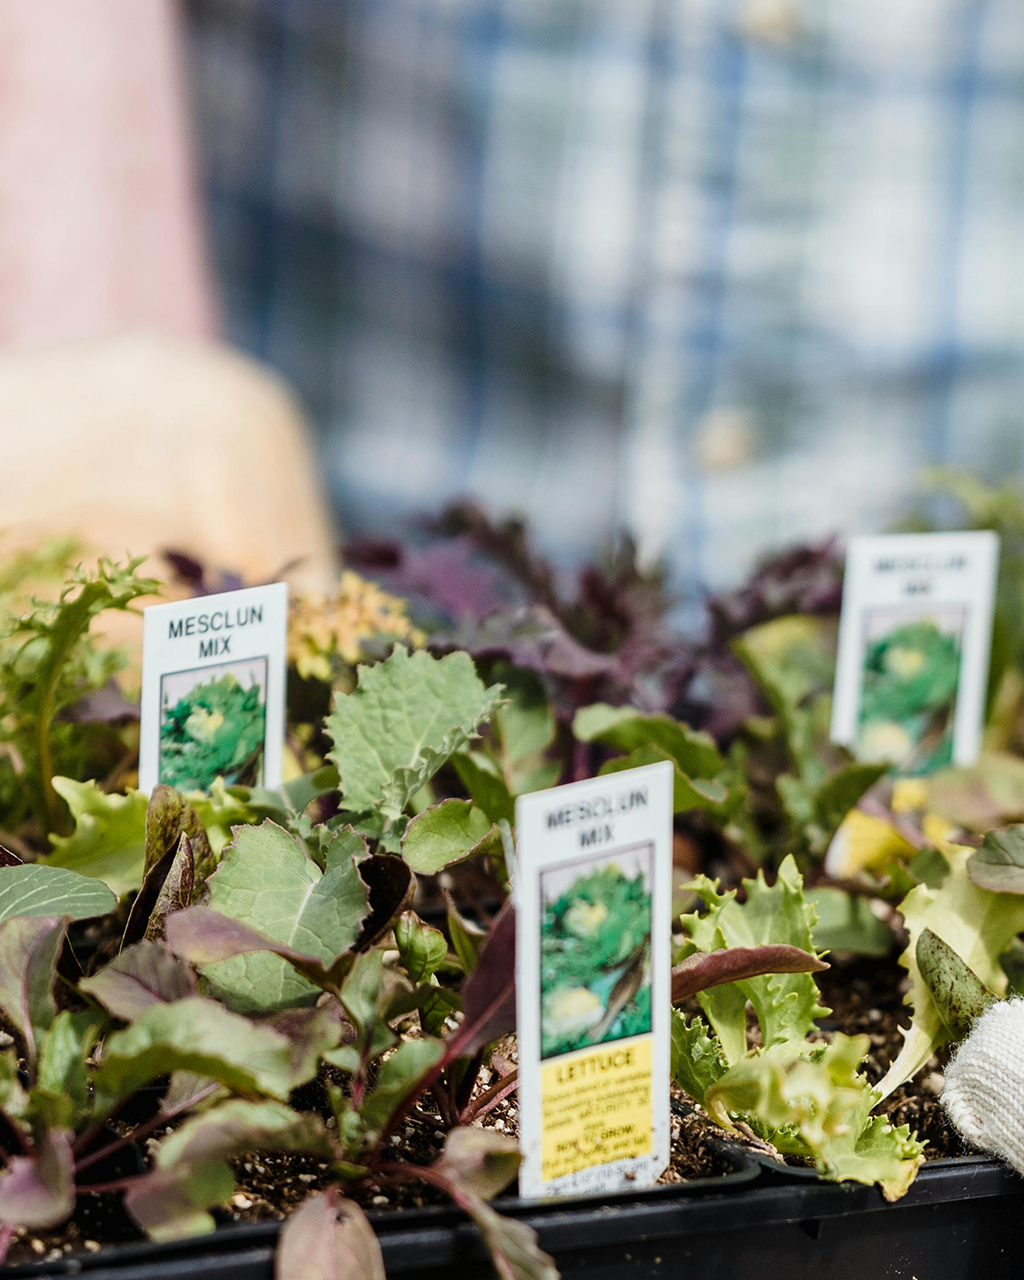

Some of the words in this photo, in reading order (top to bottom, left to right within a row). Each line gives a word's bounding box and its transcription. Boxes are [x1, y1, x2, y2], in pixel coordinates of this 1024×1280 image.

[168, 604, 264, 639] MESCLUN
[198, 635, 232, 658] MIX
[546, 787, 649, 829] MESCLUN
[579, 824, 616, 848] MIX
[557, 1048, 637, 1083] LETTUCE
